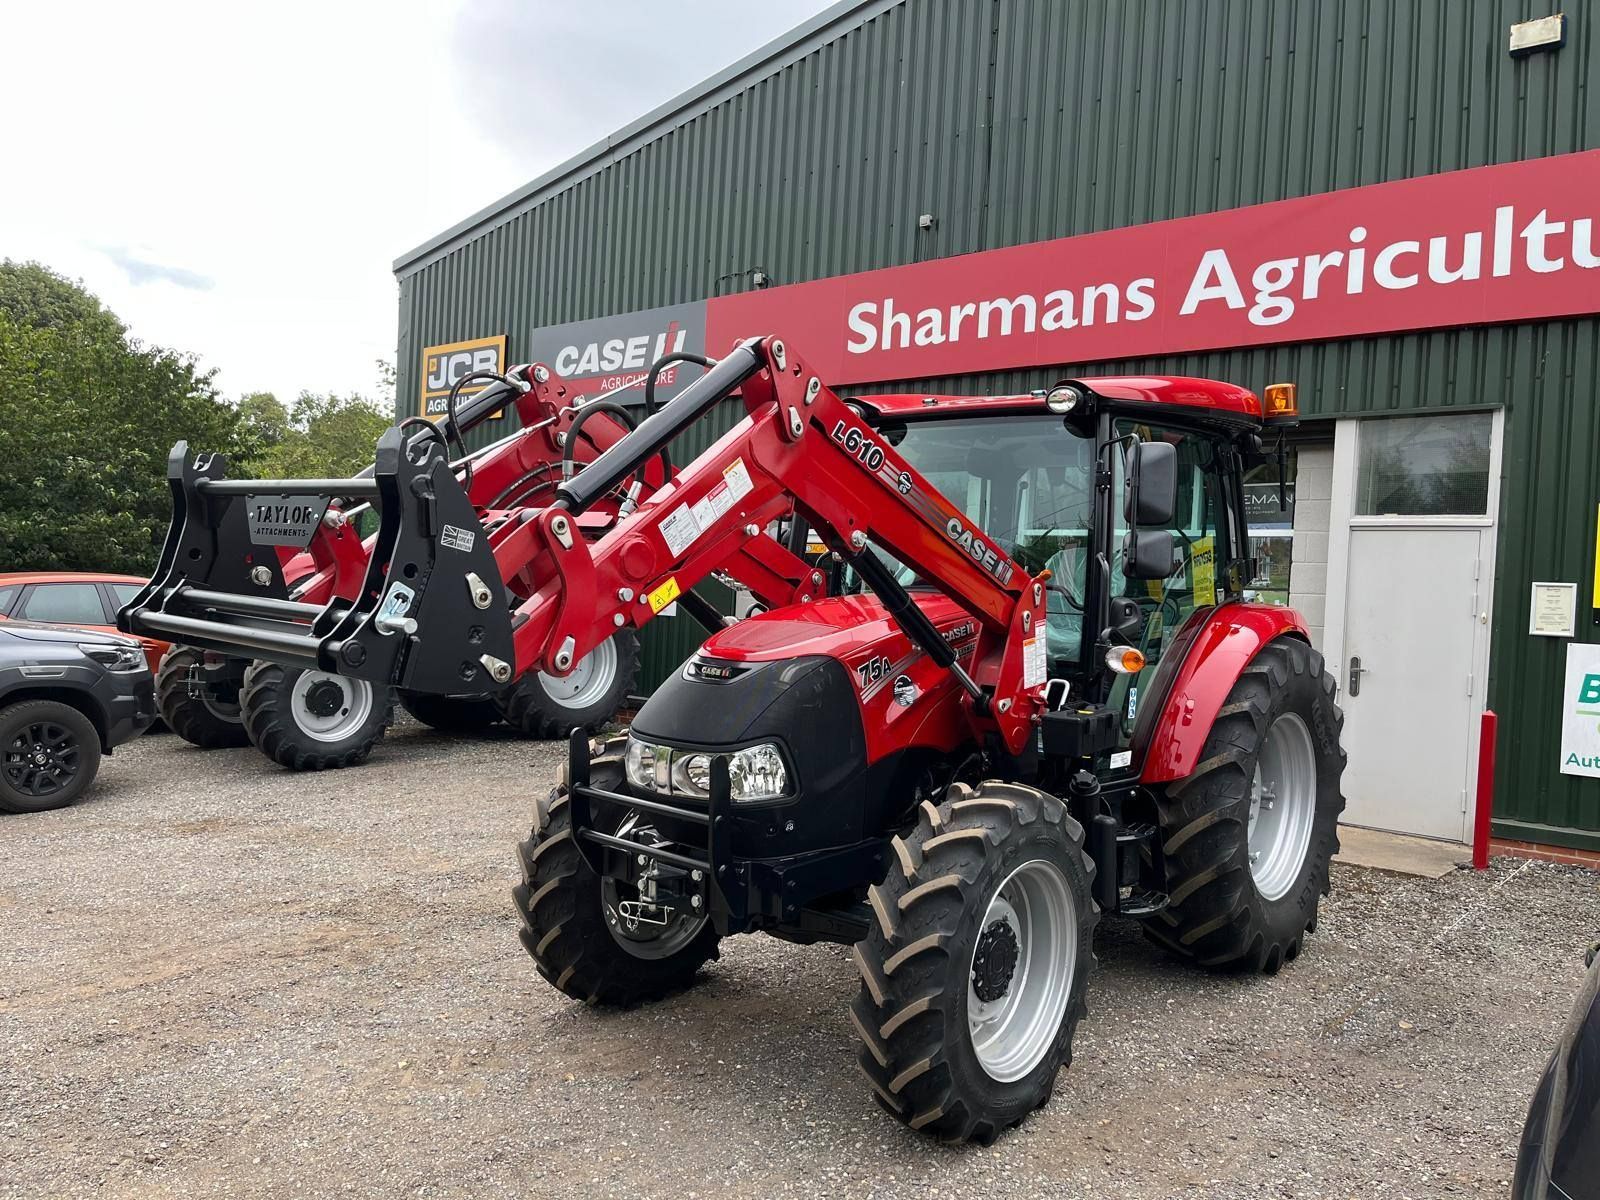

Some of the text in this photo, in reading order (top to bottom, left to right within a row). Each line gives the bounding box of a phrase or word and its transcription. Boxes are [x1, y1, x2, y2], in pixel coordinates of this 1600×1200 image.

[847, 277, 1155, 353] Sharmans
[428, 349, 497, 389] JCB
[555, 336, 649, 376] CASE
[831, 419, 884, 471] L610
[257, 505, 312, 524] TAYLOR
[946, 517, 998, 572] CASE
[943, 624, 966, 641] CASE
[701, 666, 721, 676] CASE
[857, 655, 892, 688] 75A
